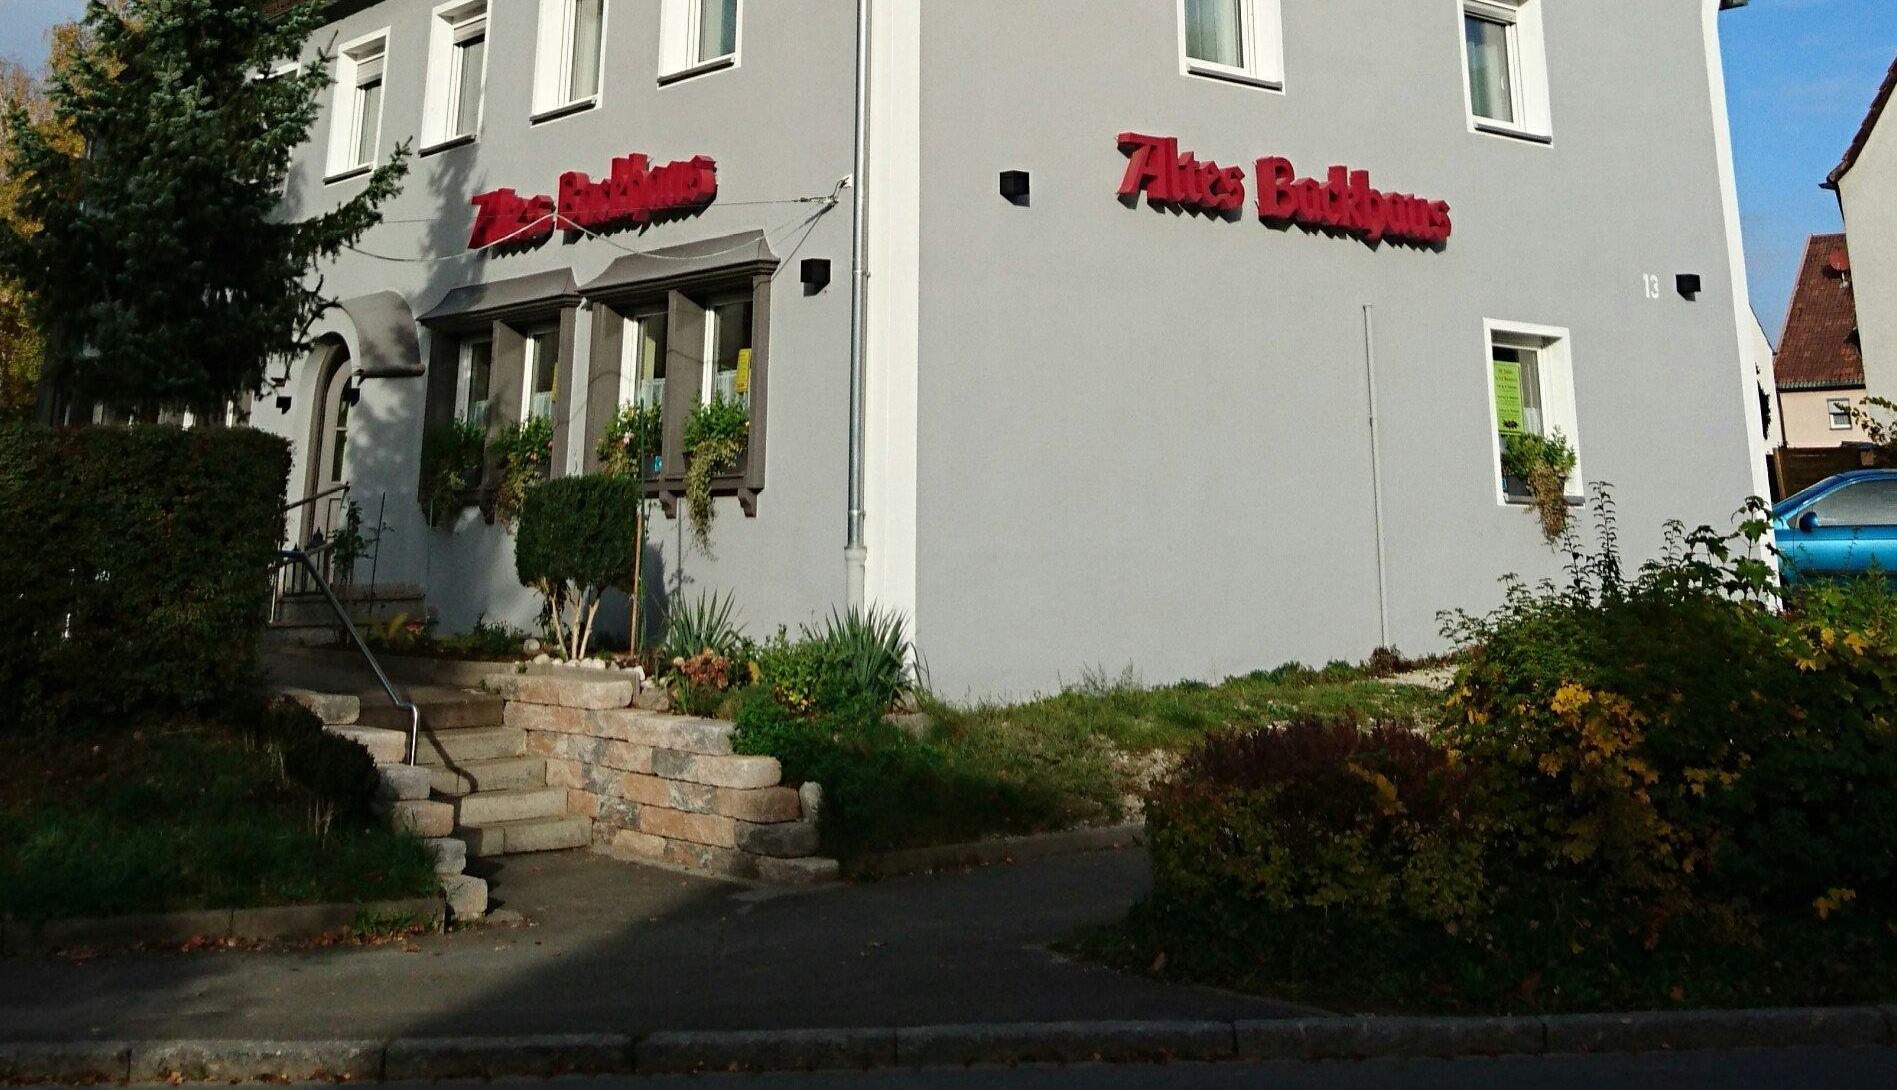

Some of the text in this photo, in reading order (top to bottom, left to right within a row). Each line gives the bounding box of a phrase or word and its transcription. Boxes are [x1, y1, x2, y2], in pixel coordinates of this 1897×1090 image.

[1115, 131, 1453, 252] Altes Backhaus
[1642, 273, 1660, 299] 13
